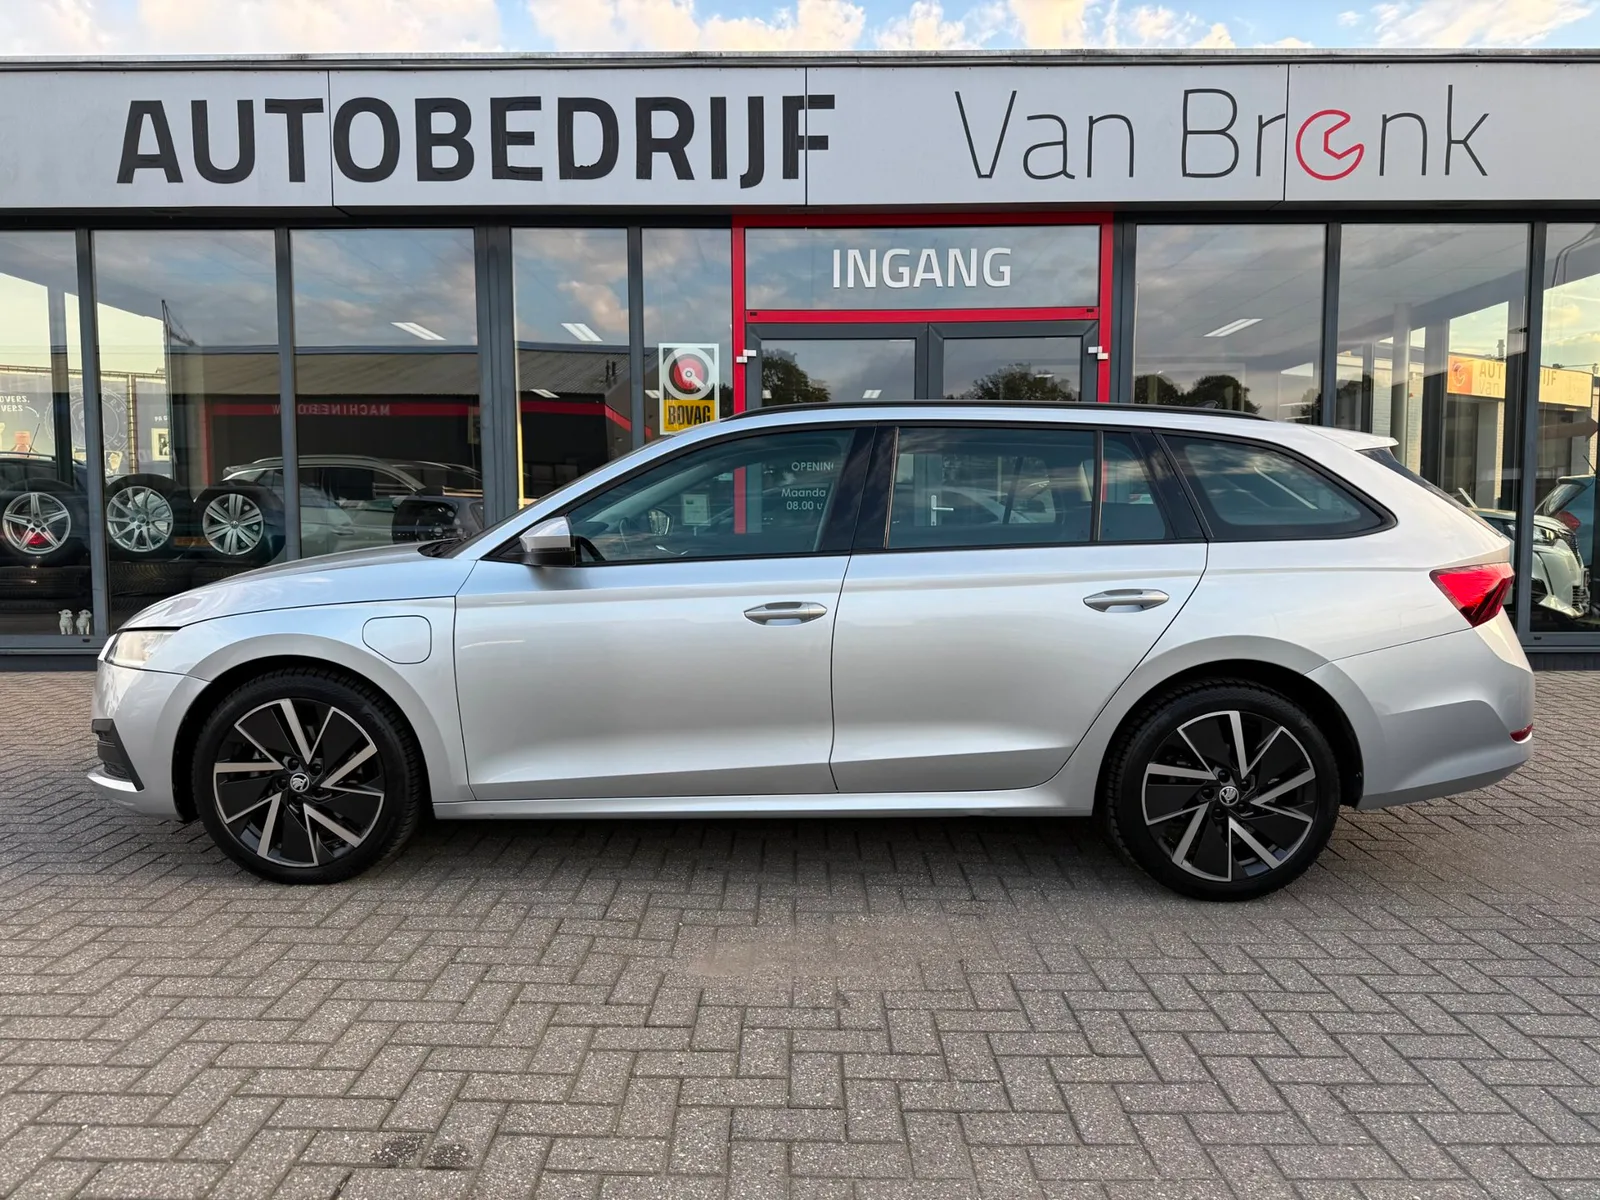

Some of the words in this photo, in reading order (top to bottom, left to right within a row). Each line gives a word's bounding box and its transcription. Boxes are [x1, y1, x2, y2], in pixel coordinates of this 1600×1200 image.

[116, 94, 835, 189] AUTOBEDRIJF
[955, 89, 1134, 180] Van
[833, 247, 1011, 288] INGANG
[668, 405, 711, 425] BOVAG
[781, 487, 826, 498] Maanda
[786, 501, 814, 511] 08.00
